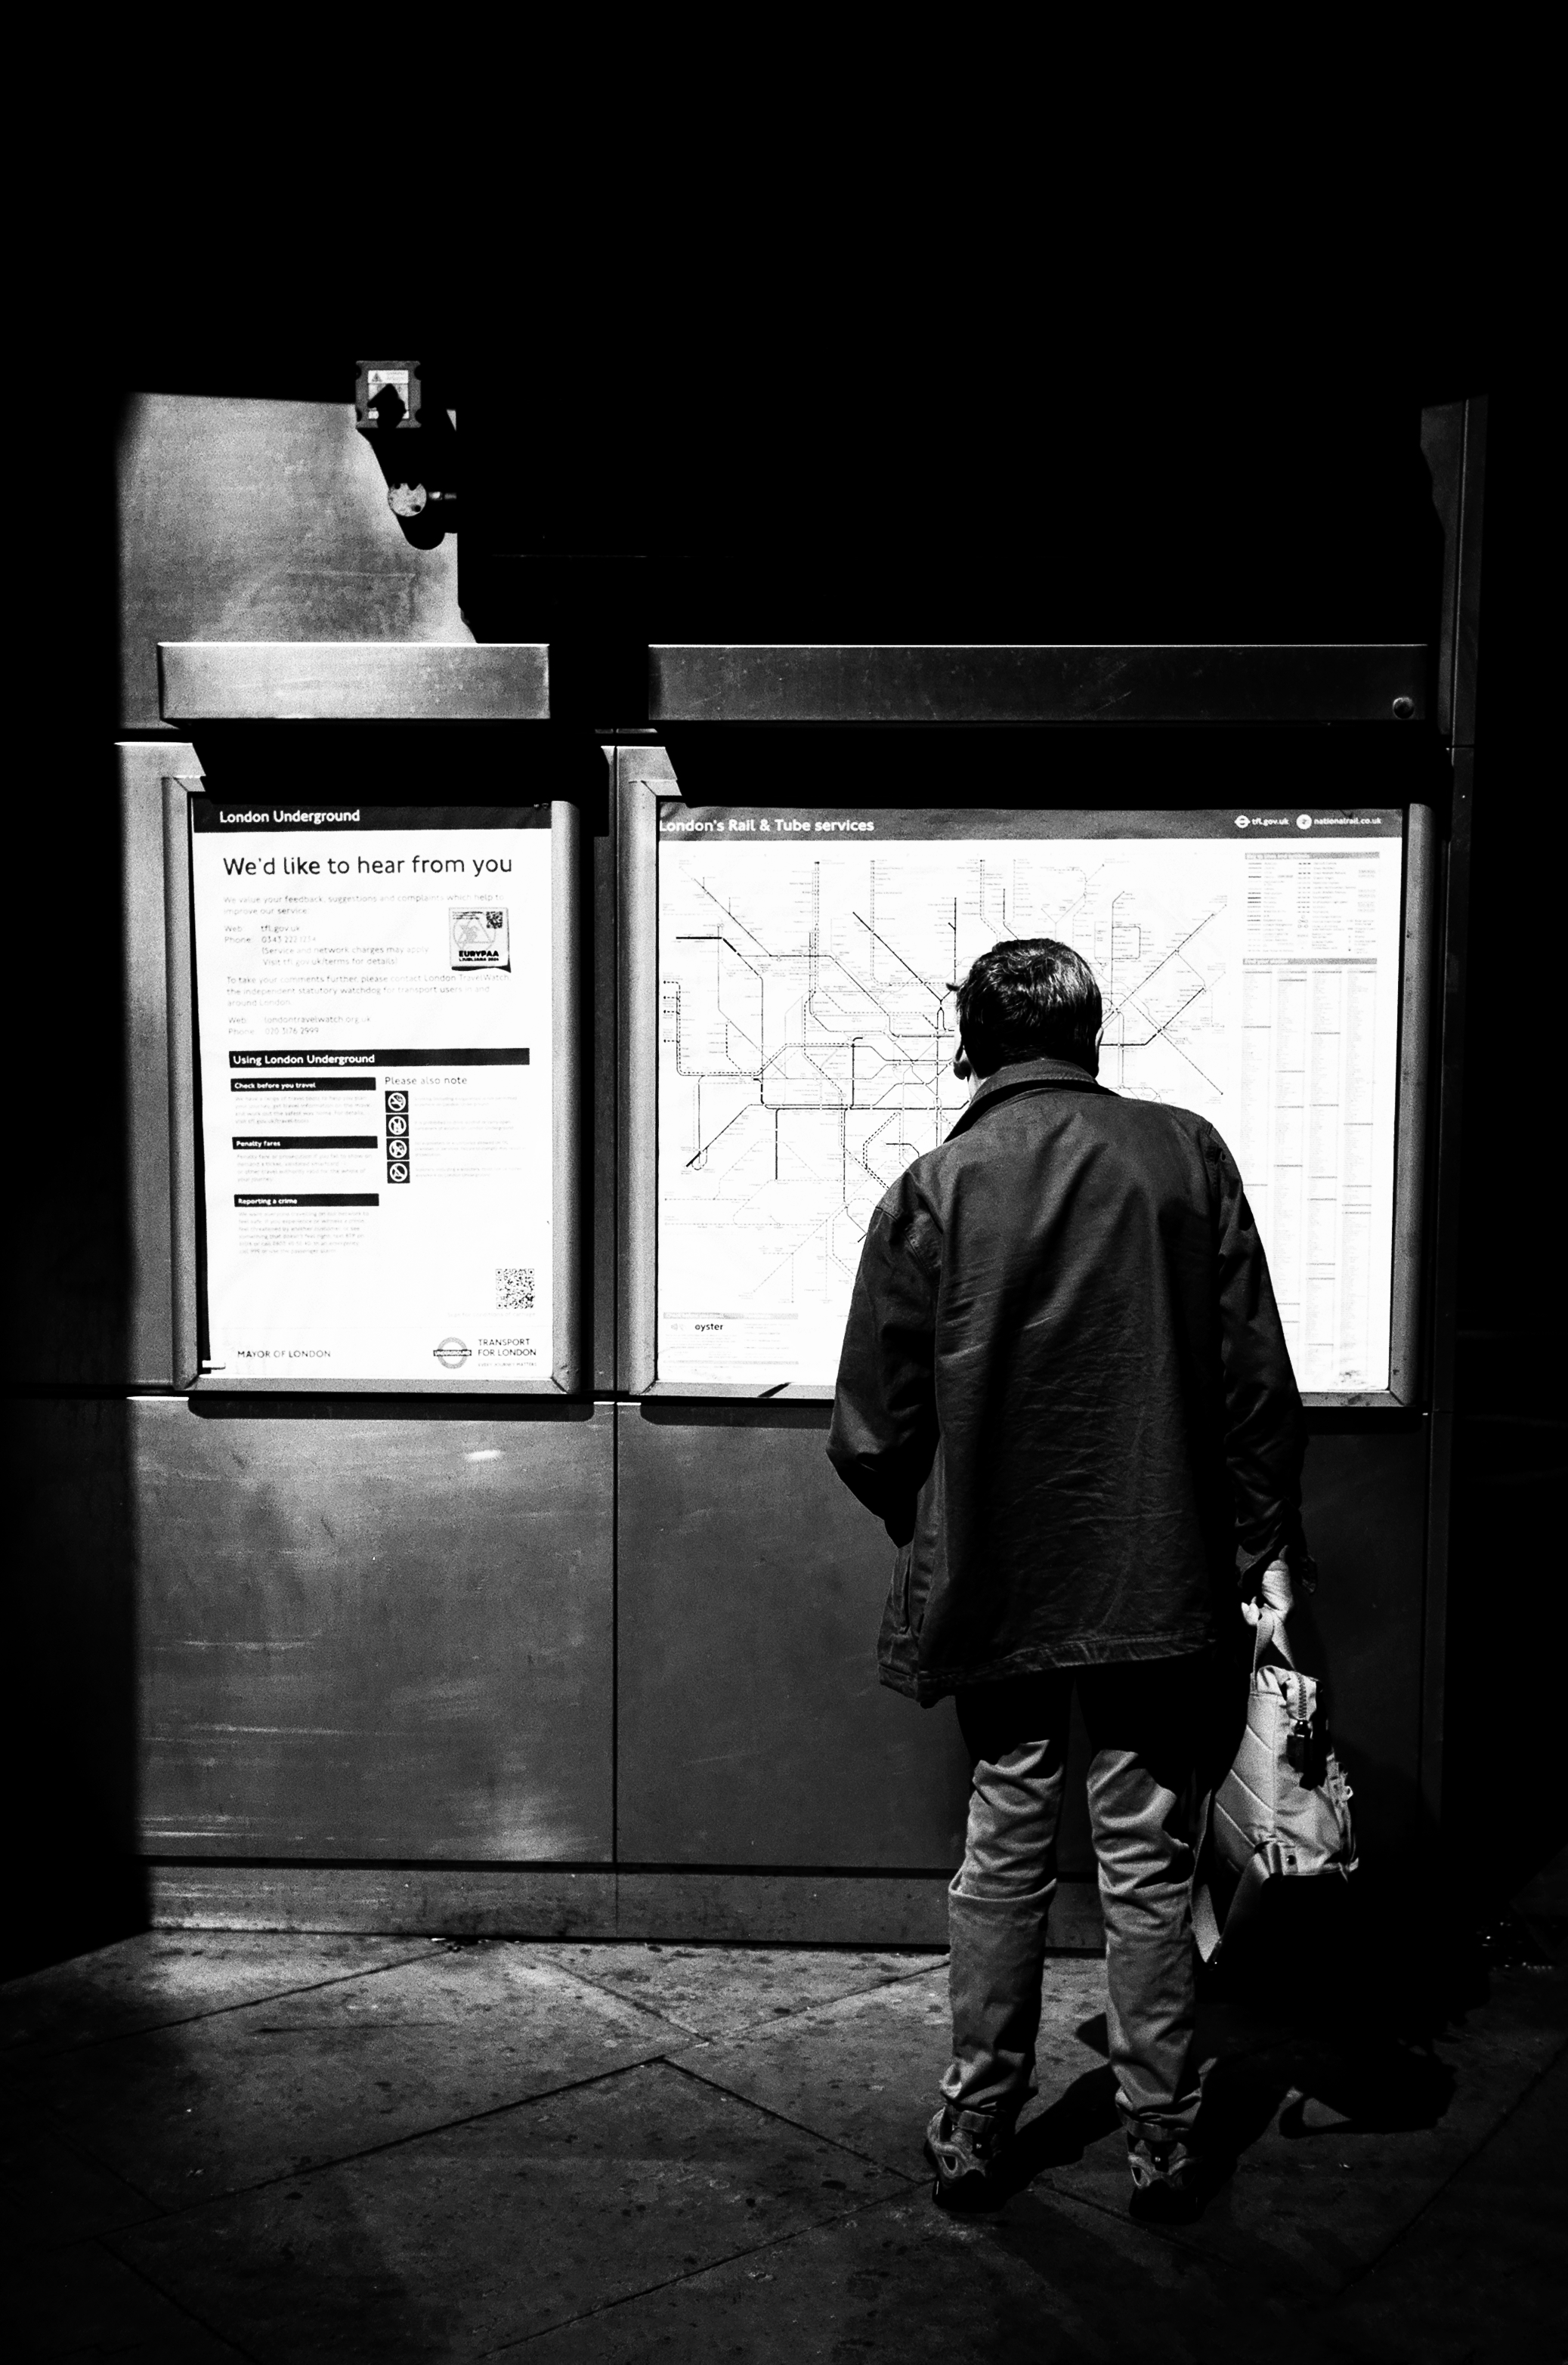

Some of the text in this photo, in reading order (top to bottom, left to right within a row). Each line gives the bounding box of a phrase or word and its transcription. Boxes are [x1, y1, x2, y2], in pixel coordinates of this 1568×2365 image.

[219, 808, 360, 825] London Underground
[660, 819, 874, 832] London's Rail & Tube services
[1252, 818, 1289, 827] tfl.gov.uk
[223, 855, 512, 877] We'd like to hear from you
[224, 896, 237, 904] We
[240, 895, 261, 904] value
[263, 897, 283, 905] your
[328, 895, 377, 904] suggestions
[397, 894, 444, 903] complaints
[447, 893, 472, 901] which
[474, 893, 493, 903] help
[261, 935, 283, 944] 0343
[284, 935, 298, 944] 222
[351, 946, 385, 955] charges
[386, 947, 404, 956] may
[227, 975, 237, 984] To
[238, 975, 256, 984] take
[258, 976, 277, 985] your
[280, 975, 325, 984] comments
[361, 975, 388, 985] please
[390, 974, 422, 982] contact
[424, 973, 456, 982] London
[227, 988, 241, 996] the
[243, 988, 295, 997] independent
[298, 987, 338, 996] statutory
[340, 986, 382, 996] watchdog
[397, 986, 438, 995] transport
[300, 1027, 320, 1035] 2999
[233, 1053, 375, 1066] Using London Underground
[385, 1076, 468, 1085] Please also note
[236, 1140, 262, 1148] Penalty
[238, 1198, 272, 1206] Reporting
[694, 1323, 725, 1332] oyster
[478, 1337, 531, 1346] TRANSPORT
[237, 1349, 332, 1359] MAYOR OF LONDON
[478, 1348, 537, 1357] FOR LONDON
